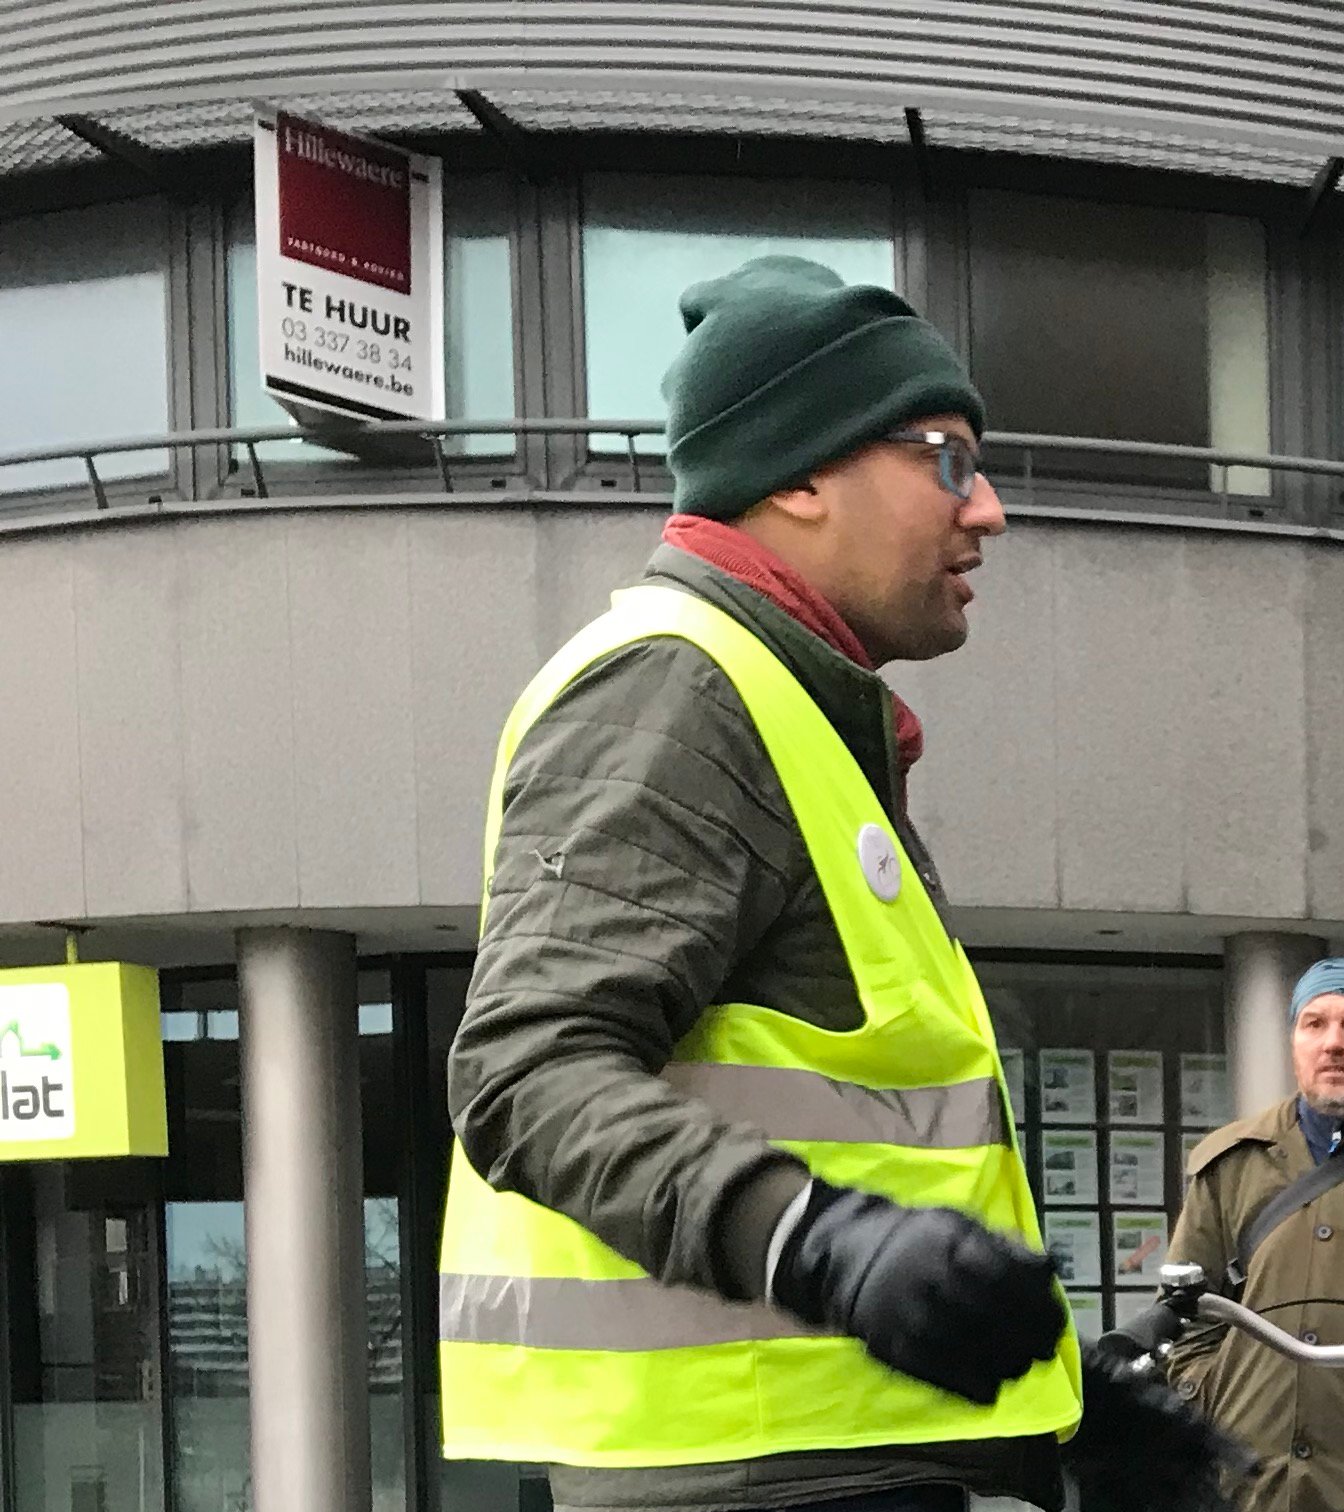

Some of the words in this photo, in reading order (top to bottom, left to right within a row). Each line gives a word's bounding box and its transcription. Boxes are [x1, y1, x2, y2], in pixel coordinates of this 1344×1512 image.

[285, 127, 401, 188] Hillewaere
[281, 281, 313, 313] TE
[326, 294, 412, 343] HUUR
[281, 317, 307, 341] 03
[314, 326, 350, 353] 337
[357, 339, 381, 364] 38
[389, 348, 412, 371] 34
[284, 342, 414, 396] hillewaere.be
